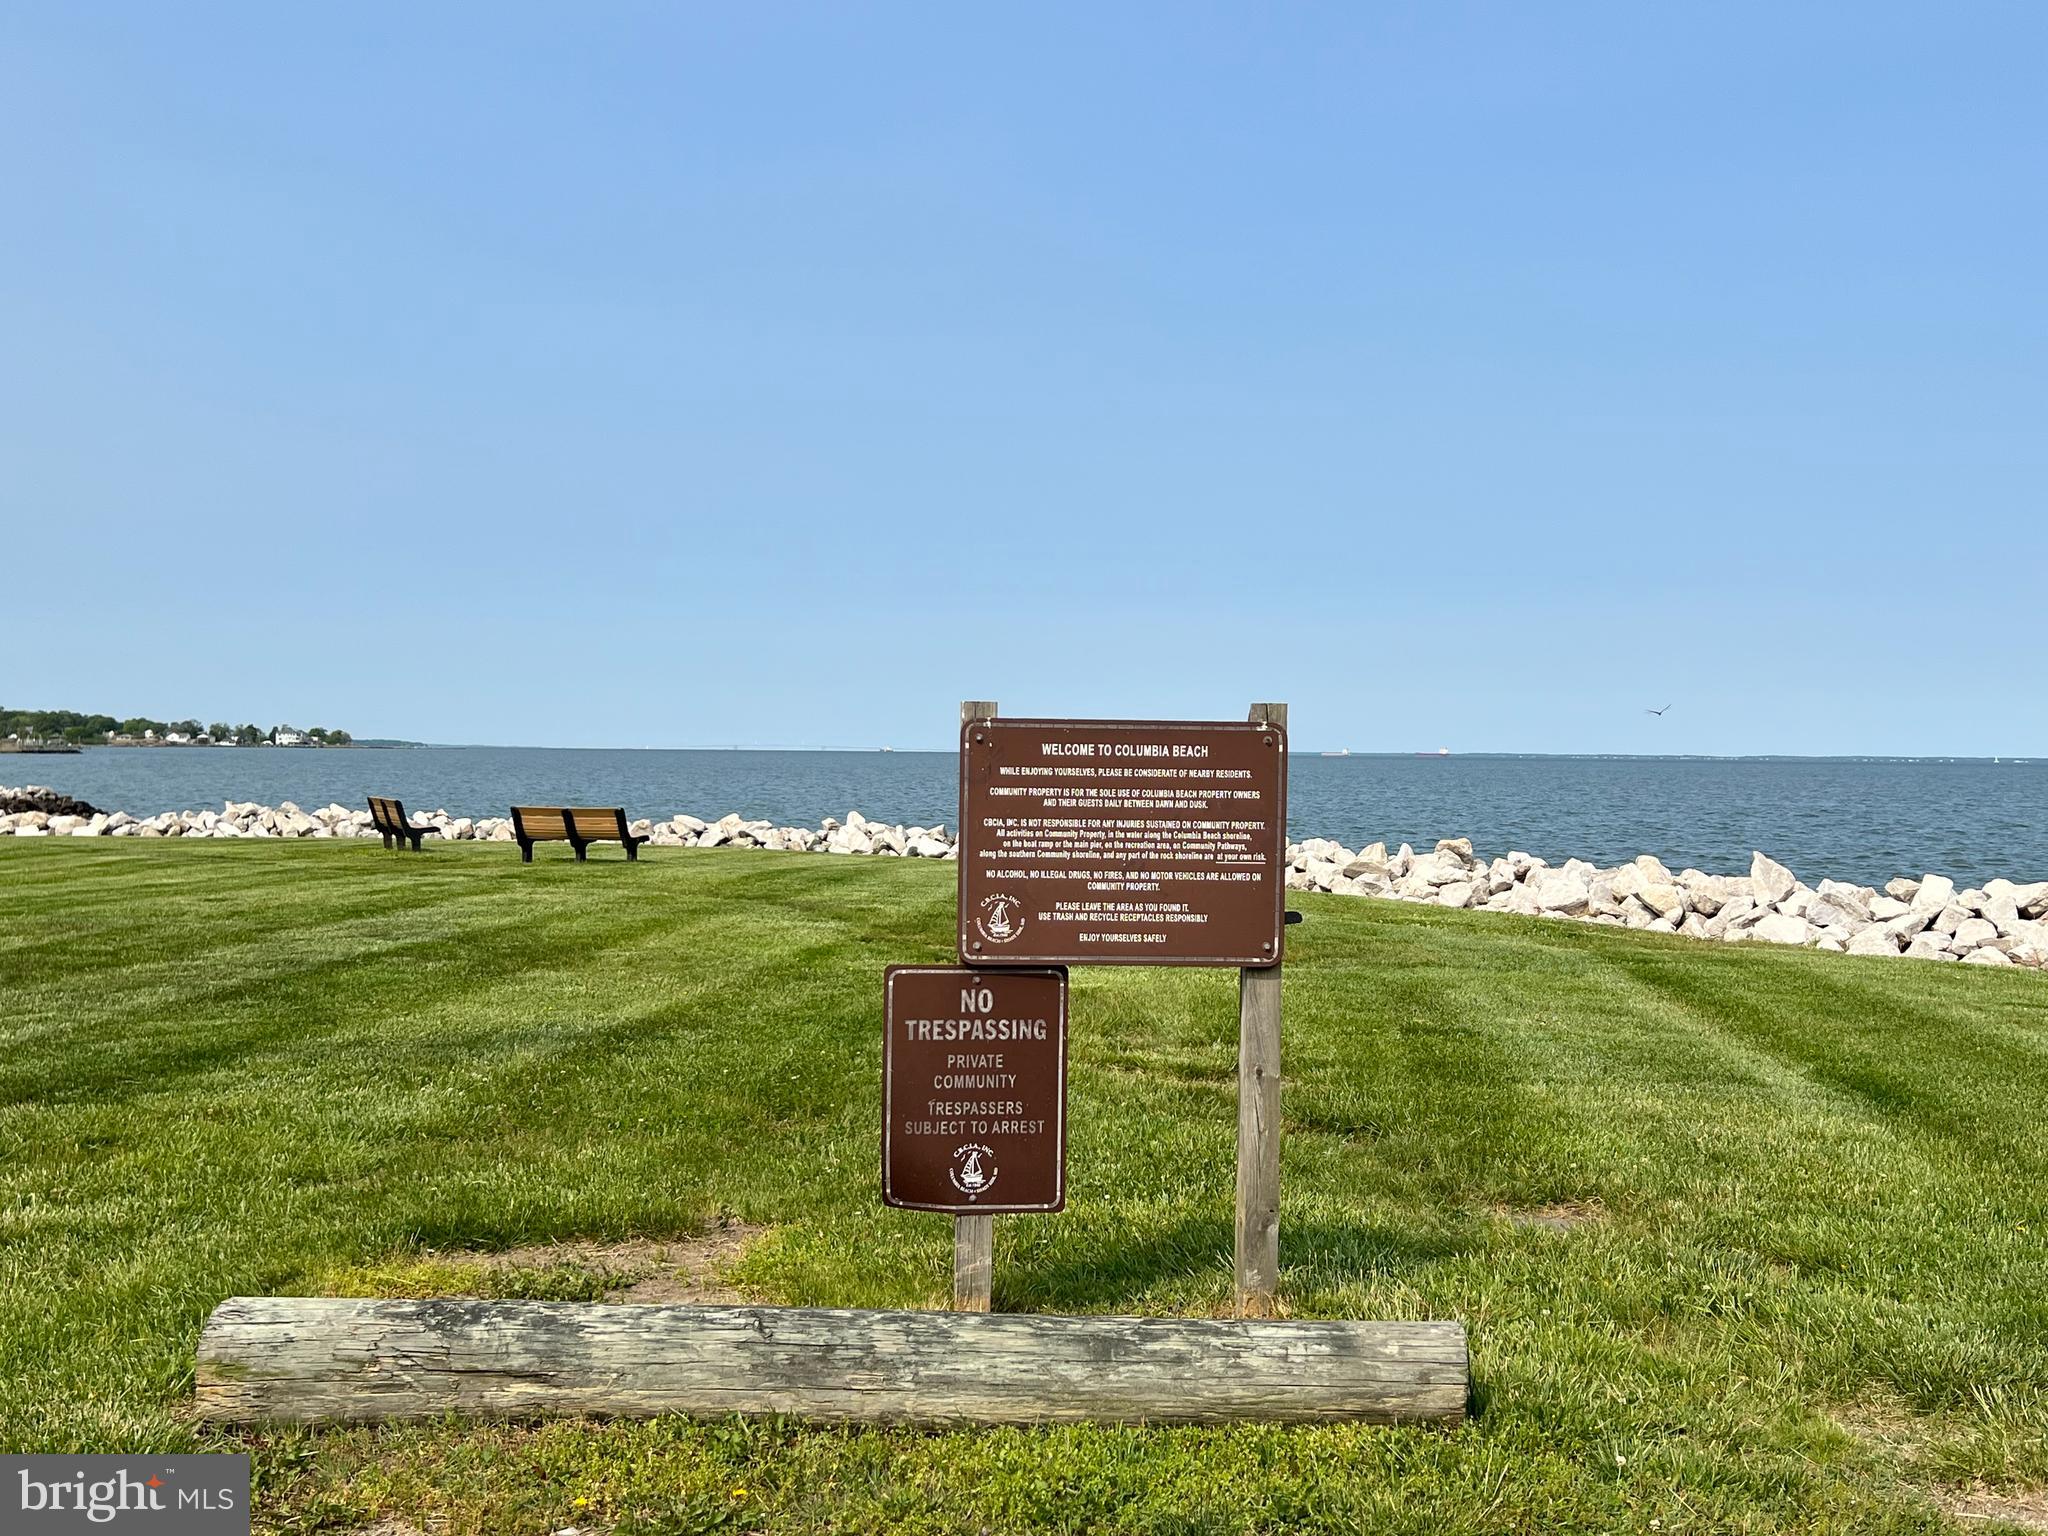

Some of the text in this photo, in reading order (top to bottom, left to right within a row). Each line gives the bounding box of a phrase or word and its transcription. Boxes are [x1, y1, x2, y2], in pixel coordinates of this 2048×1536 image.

[1041, 743, 1208, 757] WELCOME TO COLUMBIA BEACH
[999, 766, 1252, 778] WHILE ENJOYING YOURSELVES, PLEASE BE CONSIDERATE OF NEARBY RESIDENTS.
[989, 786, 1260, 799] COMMUNITY PROPERTY IS FOR THE SOLE USE OF COLUMBIA BEACH PROPERTY OWNERS
[1042, 798, 1208, 808] AND THEIR GUESTS DAILY BETWEEN DAWN AND DUSK.
[1020, 818, 1027, 826] IS
[1028, 818, 1041, 827] NOT
[1042, 818, 1086, 827] RESPONSIBLE
[1087, 819, 1100, 828] FOR
[1102, 819, 1115, 828] ANY
[1116, 819, 1144, 828] INJURIES
[1145, 819, 1180, 829] SUSTAINED
[1181, 820, 1191, 829] ON
[1192, 820, 1230, 829] COMMUNITY
[996, 828, 1005, 837] All
[1006, 828, 1034, 837] activities
[1044, 829, 1078, 840] Community
[1079, 829, 1106, 840] Property,
[1107, 830, 1114, 838] in
[1114, 830, 1125, 838] the
[1126, 830, 1142, 839] water
[1143, 830, 1160, 841] along
[1161, 830, 1172, 839] the
[1172, 830, 1201, 839] Columbia
[1202, 831, 1221, 840] Beach
[1222, 831, 1252, 841] shoreline,
[1012, 839, 1022, 847] the
[1022, 839, 1037, 847] boat
[1038, 841, 1054, 850] ramp
[1062, 839, 1072, 848] the
[1073, 839, 1088, 848] main
[1089, 840, 1103, 850] pier,
[1113, 840, 1123, 848] the
[1124, 840, 1155, 849] recreation
[1182, 840, 1215, 851] Community
[1216, 841, 1247, 852] Pathways,
[979, 849, 996, 859] along
[997, 849, 1007, 858] the
[1008, 849, 1035, 858] southern
[1036, 849, 1070, 860] Community
[1071, 850, 1101, 860] shoreline,
[1102, 850, 1114, 859] and
[1115, 852, 1126, 861] any
[1127, 850, 1140, 861] part
[1141, 851, 1148, 859] of
[1148, 851, 1159, 859] the
[1160, 851, 1173, 860] rock
[1174, 851, 1202, 860] shoreline
[1216, 852, 1223, 860] at
[1224, 854, 1238, 862] your
[986, 869, 1261, 881] NO ALCOHOL, NO ILLEGAL DRUGS, NO FIRES, AND NO MOTOR VEHICLES ARE ALLOWED ON
[1087, 881, 1124, 890] COMMUNITY
[1055, 901, 1080, 910] PLEASE
[1081, 902, 1101, 911] LEAVE
[1102, 902, 1115, 911] THE
[1115, 902, 1134, 911] AREA
[1134, 902, 1143, 911] AS
[1144, 902, 1158, 912] YOU
[1158, 903, 1181, 912] FOUND
[1038, 911, 1208, 922] USE TRASH AND RECYCLE RECEPTACLES RESPONSIBLY
[1079, 932, 1166, 942] ENJOY YOURSELVES SAFELY
[960, 988, 993, 1013] NO
[904, 1019, 1046, 1040] TRESPASSING
[947, 1054, 1003, 1068] PRIVATE
[934, 1074, 1016, 1088] COMMUNITY
[928, 1100, 1023, 1115] TRESPASSERS
[905, 1120, 1044, 1134] SUBJECT TO ARREST
